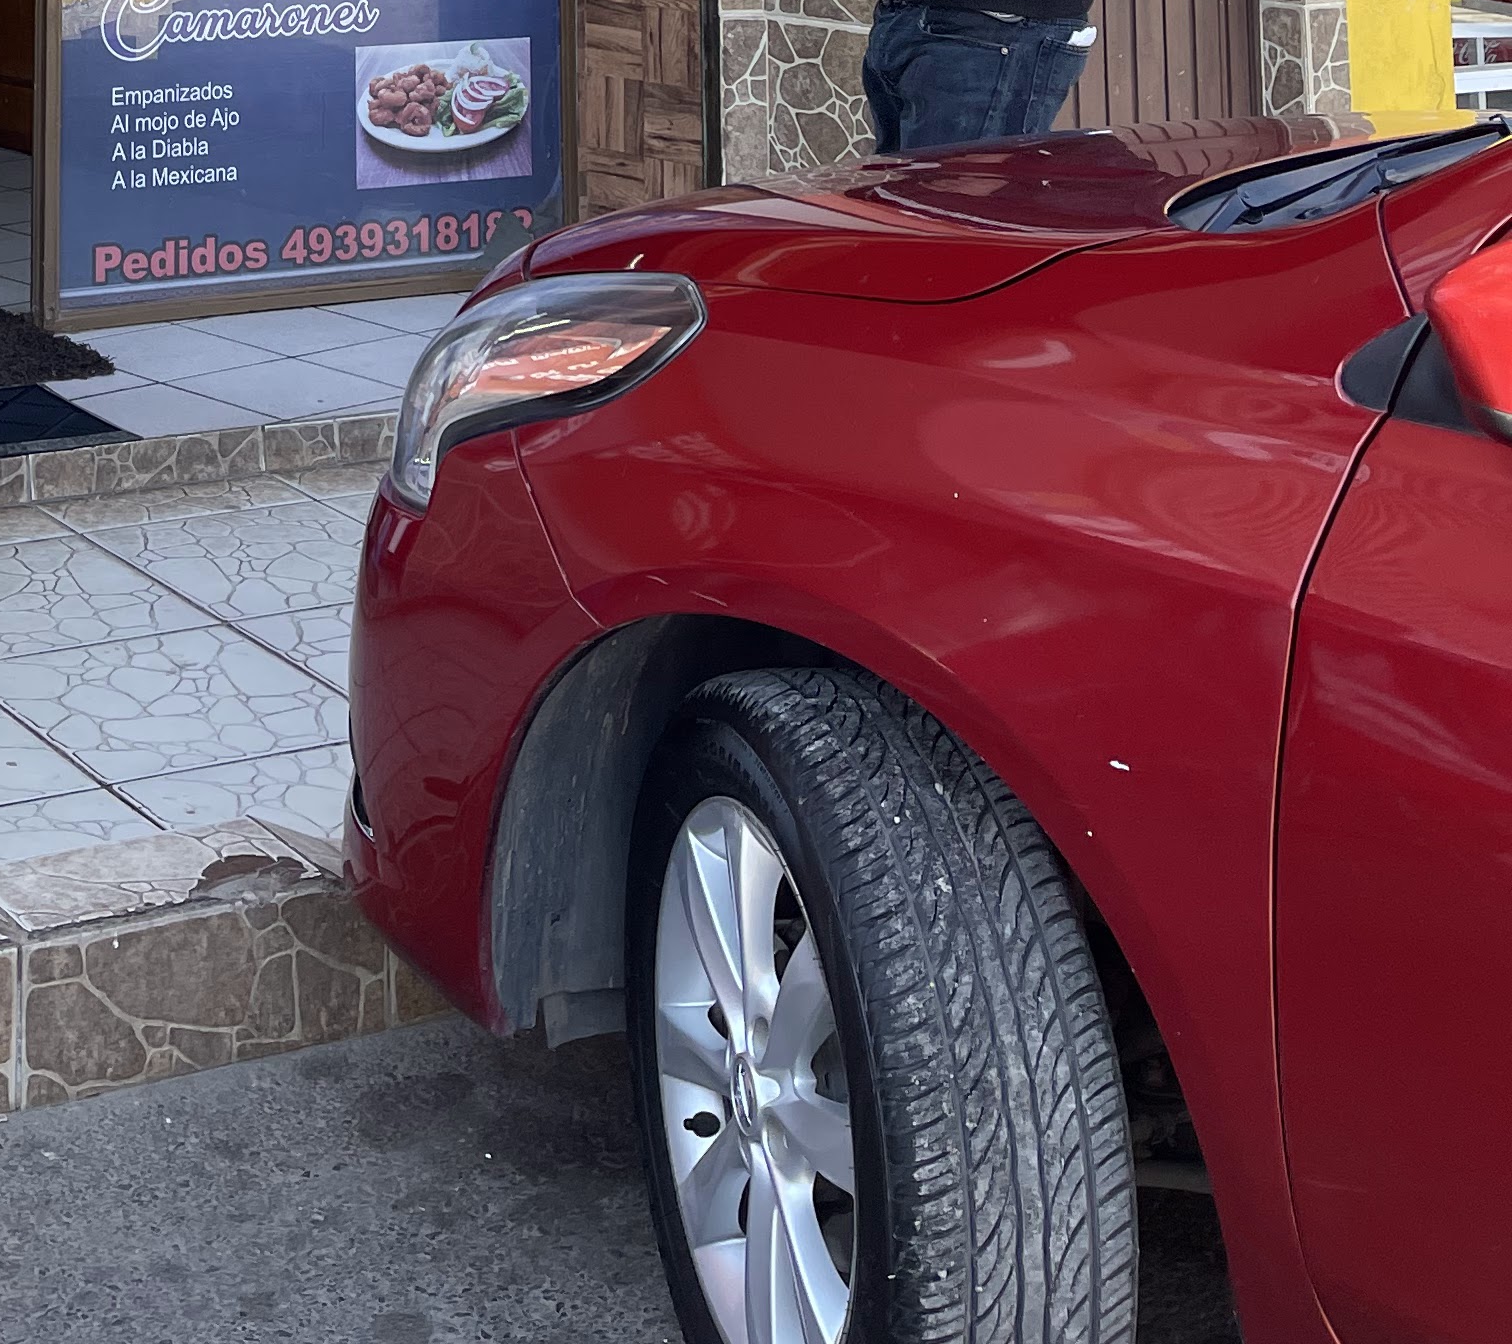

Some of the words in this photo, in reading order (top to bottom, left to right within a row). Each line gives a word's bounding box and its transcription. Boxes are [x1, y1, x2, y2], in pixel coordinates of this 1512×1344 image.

[111, 82, 233, 107] Empanizados
[111, 115, 129, 134] Al
[134, 112, 179, 136] mojo
[184, 109, 206, 128] de
[210, 108, 240, 131] Ajo
[111, 143, 127, 161] A
[131, 141, 146, 161] la
[152, 137, 209, 159] Diabla
[111, 172, 127, 190] A
[131, 170, 146, 189] la
[152, 165, 238, 187] Mexicana
[93, 237, 267, 285] Pedidos
